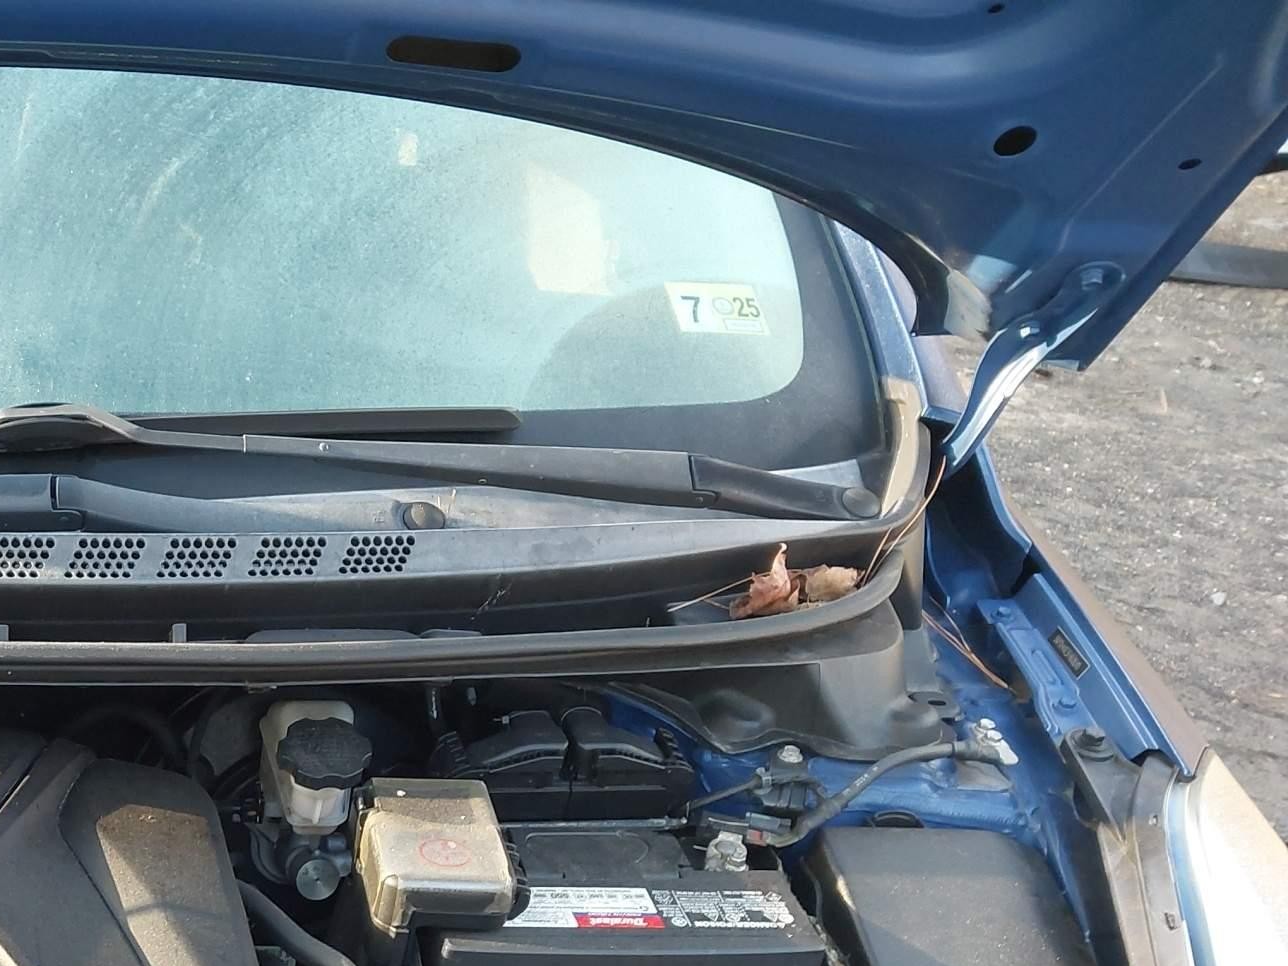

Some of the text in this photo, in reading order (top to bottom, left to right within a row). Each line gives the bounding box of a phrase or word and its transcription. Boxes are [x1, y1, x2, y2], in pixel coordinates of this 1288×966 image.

[680, 295, 700, 323] 7
[732, 296, 761, 318] 25
[589, 917, 649, 928] Duralast
